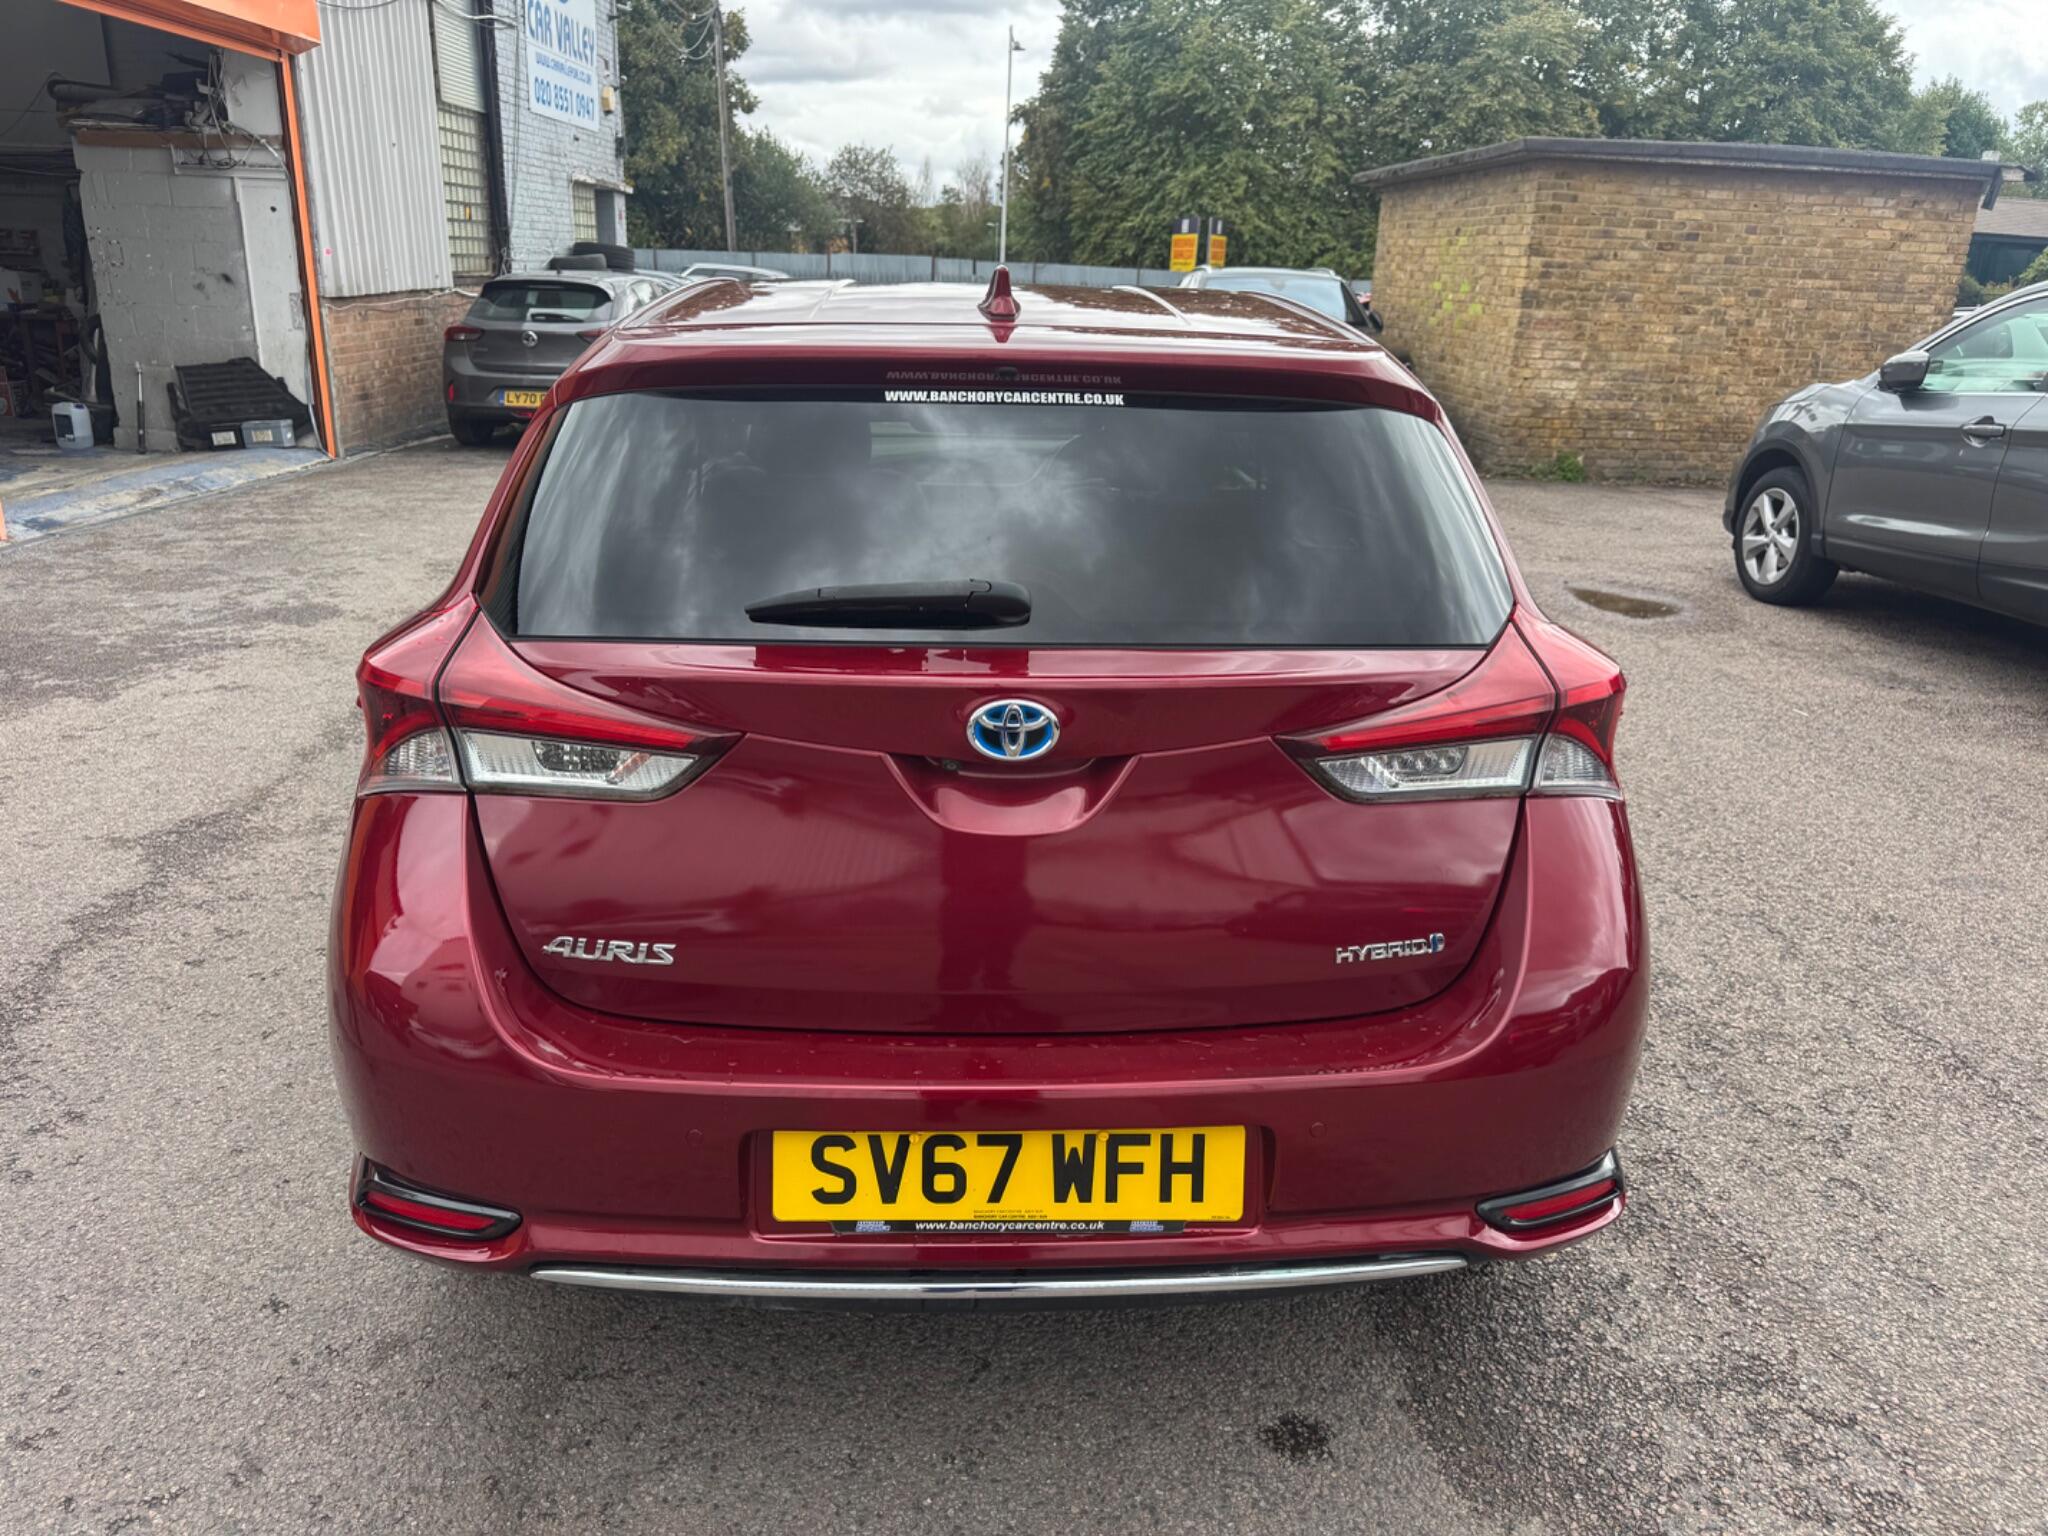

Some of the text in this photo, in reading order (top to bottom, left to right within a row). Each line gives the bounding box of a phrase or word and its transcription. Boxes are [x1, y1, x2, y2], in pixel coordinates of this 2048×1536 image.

[527, 0, 595, 66] CAR VALLEY
[534, 76, 595, 121] 020 8551 0947
[506, 392, 537, 404] LY70
[885, 390, 1125, 405] WWW.BANCHORYCARCENTRE.CO.UK
[542, 935, 676, 965] AURIS
[1336, 938, 1428, 964] HYBRID
[811, 1133, 1206, 1205] SV67 WFH
[915, 1220, 1105, 1233] www.banchorycarcentre.co.uk
